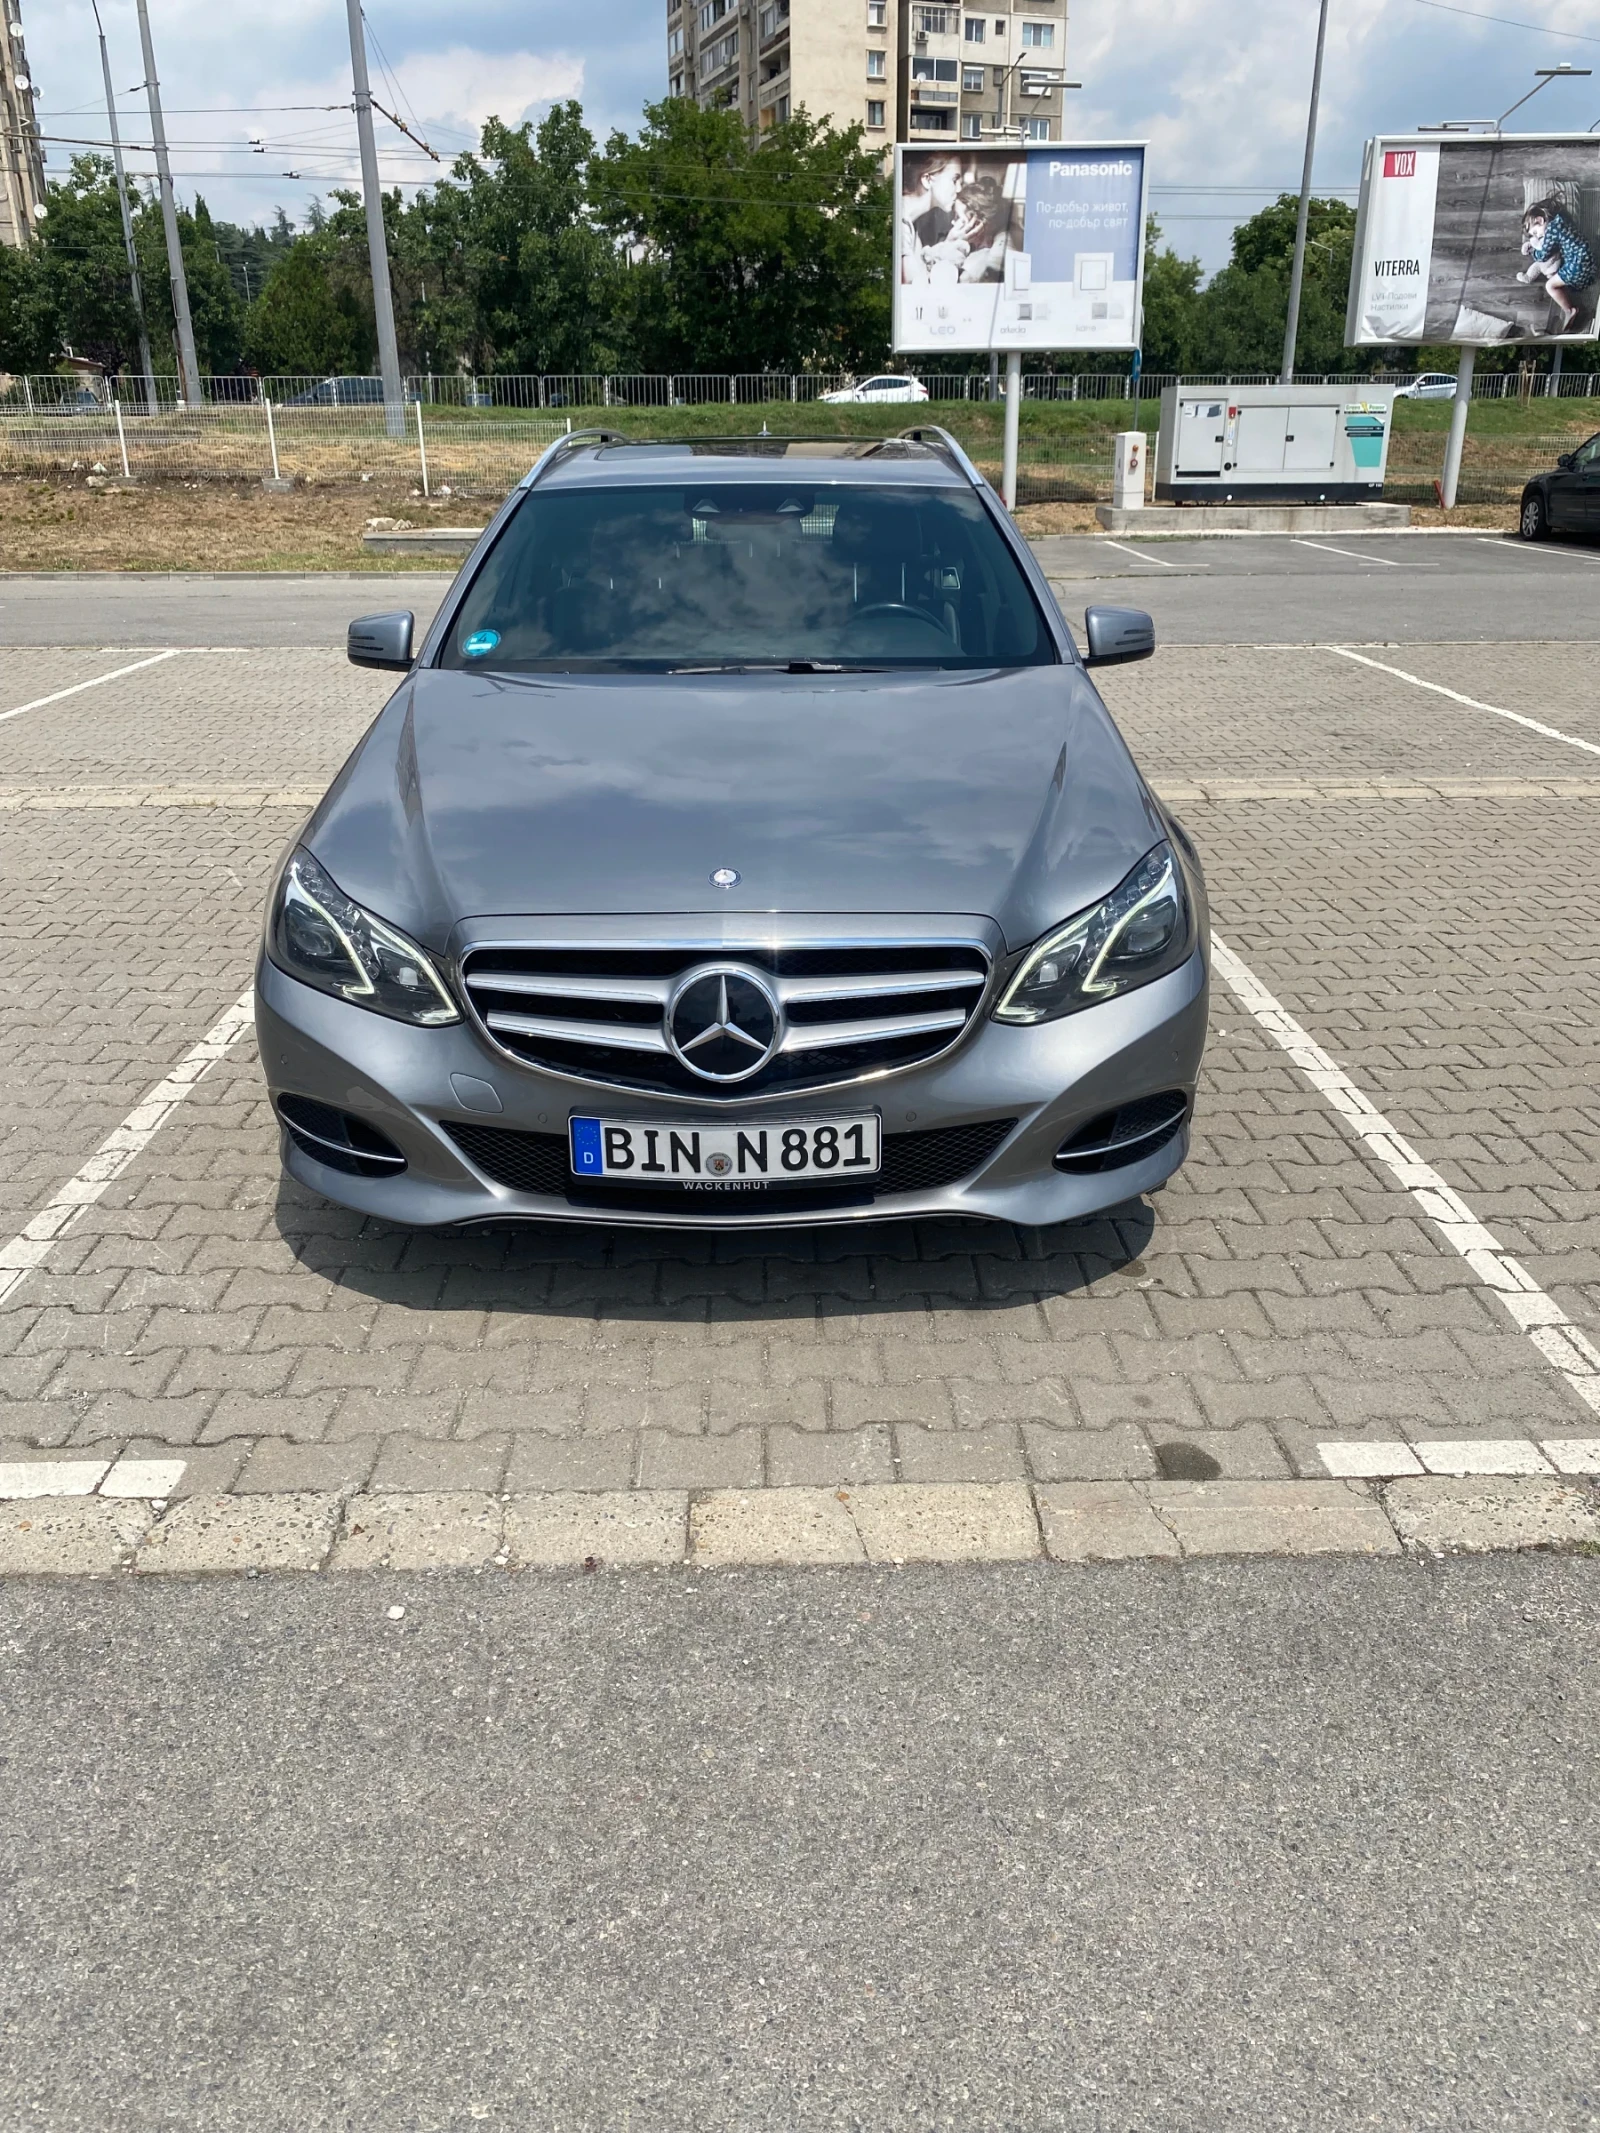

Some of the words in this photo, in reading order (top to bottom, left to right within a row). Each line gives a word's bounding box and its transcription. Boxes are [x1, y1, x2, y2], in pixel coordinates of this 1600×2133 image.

[1049, 160, 1133, 177] Panasonic
[1394, 152, 1415, 176] VOX
[1036, 200, 1090, 214] По-добър
[1048, 216, 1101, 231] по-добър
[1103, 217, 1129, 229] свят
[1374, 259, 1420, 277] VITERRA
[604, 1126, 702, 1173] BIN
[737, 1130, 768, 1173] N
[780, 1123, 871, 1173] 881
[583, 1151, 594, 1164] D
[682, 1181, 770, 1191] WACKENHUT
